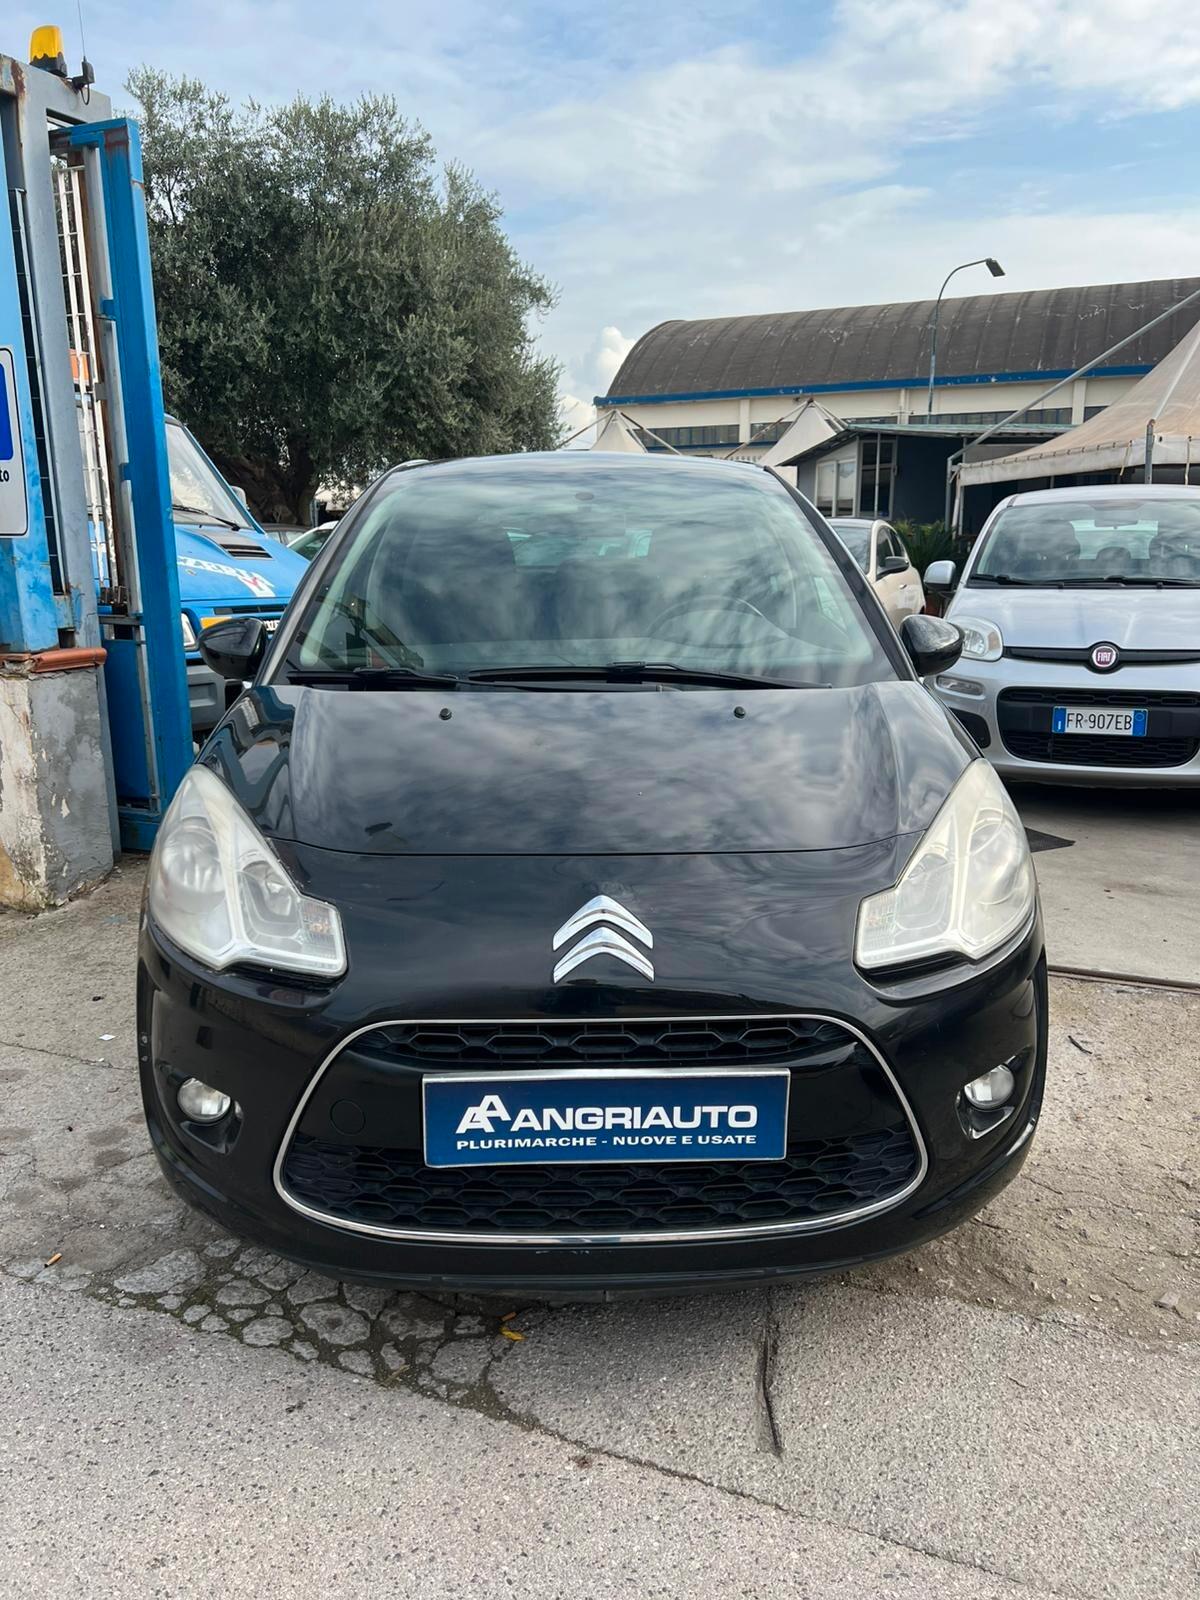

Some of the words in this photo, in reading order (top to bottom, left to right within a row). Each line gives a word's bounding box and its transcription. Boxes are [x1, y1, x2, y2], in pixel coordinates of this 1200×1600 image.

[1097, 652, 1112, 662] FIAT
[1066, 712, 1084, 729] FR
[1088, 713, 1133, 731] 907EB
[510, 1105, 758, 1132] ANGRIAUTO
[456, 1136, 597, 1150] PLURIMARCHE
[613, 1135, 677, 1146] NUOVE
[681, 1135, 693, 1145] E
[697, 1134, 757, 1145] USATE
